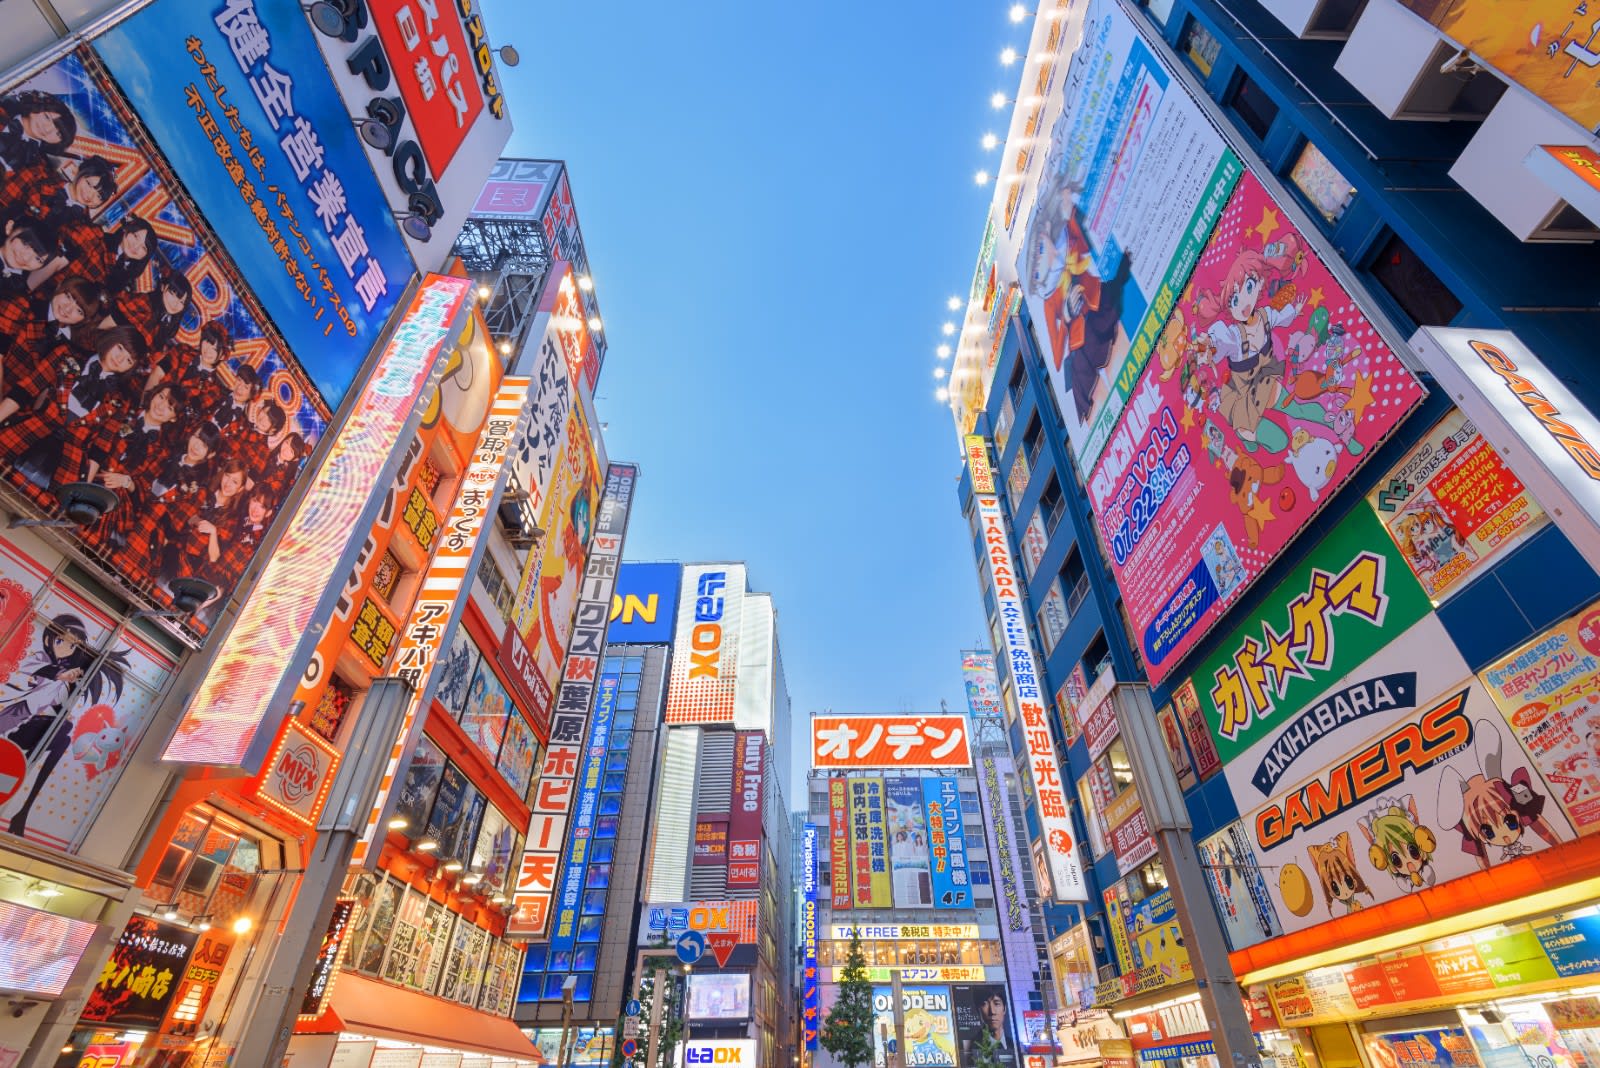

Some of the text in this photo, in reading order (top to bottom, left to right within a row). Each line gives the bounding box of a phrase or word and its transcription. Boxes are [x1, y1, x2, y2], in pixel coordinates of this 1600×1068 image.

[213, 0, 388, 313] 健全営業宣言
[481, 420, 513, 464] 買取り
[1131, 407, 1179, 488] Vol.1
[597, 467, 621, 531] PARADISE
[615, 465, 636, 512] HOBBY
[1460, 473, 1499, 508] オリジナル
[1112, 484, 1154, 567] 07.22
[1413, 525, 1456, 564] SAMPLE
[982, 515, 1017, 599] TAKARADA
[1010, 649, 1040, 700] 免税商店
[816, 719, 964, 760] オノデン
[1264, 680, 1397, 783] AKIHABARA
[278, 755, 319, 792] MAX
[743, 735, 763, 812] Duty Free
[1256, 686, 1472, 851] GAMERS
[803, 829, 815, 894] Panasonic
[928, 801, 949, 874] 大特売中!!
[942, 891, 966, 905] 4F
[195, 938, 229, 967] 入口
[713, 939, 734, 948] 止まれ
[805, 900, 816, 959] ONODEN
[837, 927, 863, 938] TAX
[865, 926, 899, 938] FREE
[900, 925, 931, 938] 免税店
[901, 968, 938, 980] エアコン
